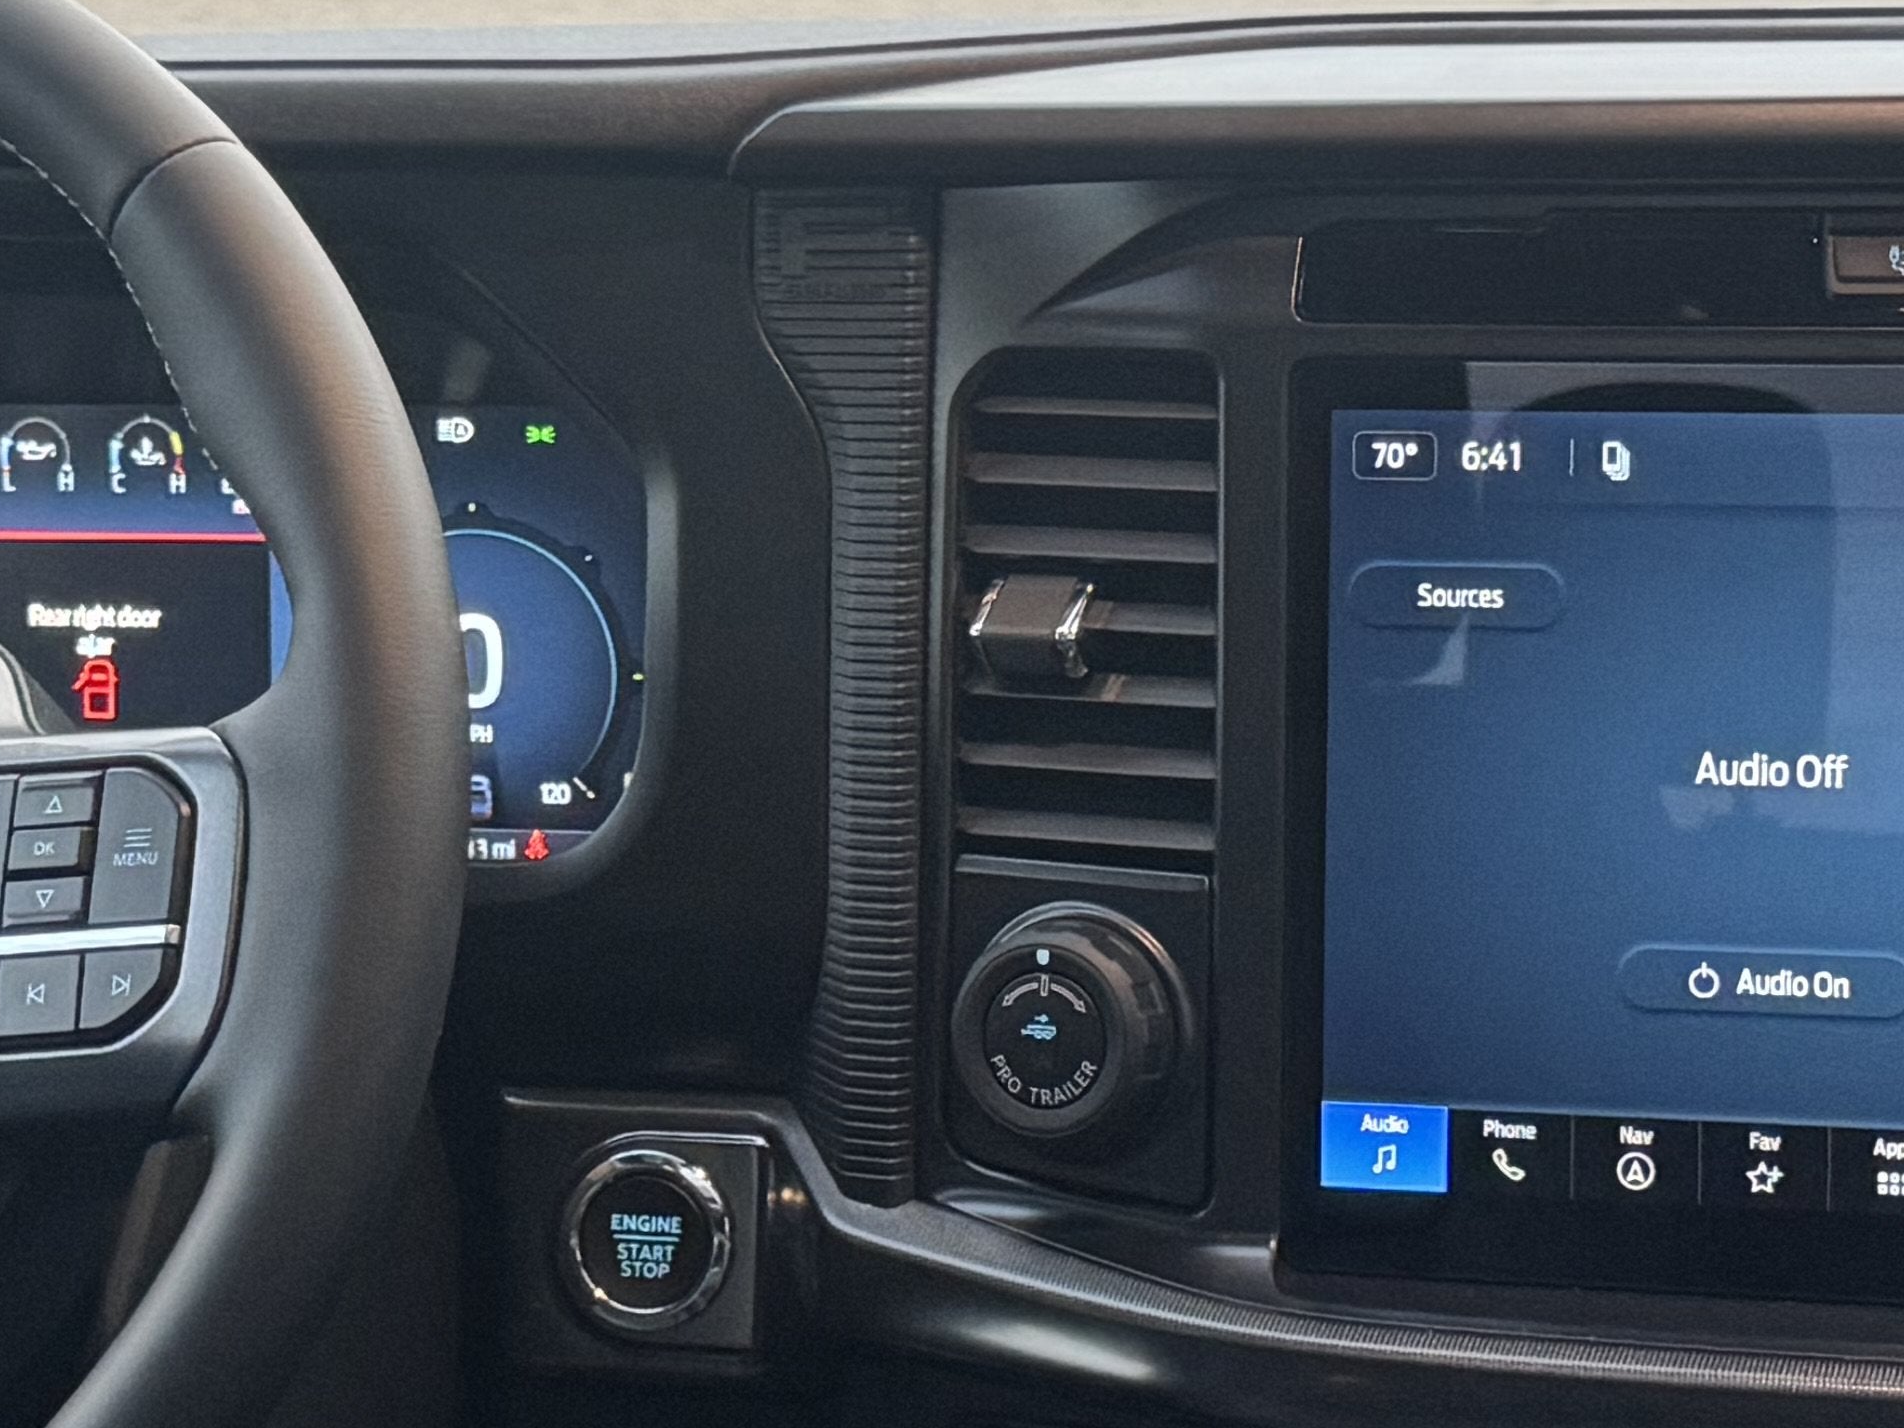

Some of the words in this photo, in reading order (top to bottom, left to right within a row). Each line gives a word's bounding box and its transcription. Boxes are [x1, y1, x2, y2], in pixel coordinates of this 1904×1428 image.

[1371, 441, 1419, 469] 70°
[1461, 441, 1522, 472] 6:41
[1, 471, 17, 492] L
[57, 471, 75, 492] H
[109, 471, 127, 494] C
[169, 472, 186, 494] H
[1416, 582, 1505, 609] Sources
[27, 602, 71, 627] Rear
[72, 603, 116, 631] right
[117, 604, 163, 629] door
[468, 724, 494, 745] PH
[1695, 750, 1790, 788] Audio
[1796, 753, 1850, 789] Off
[540, 781, 571, 806] 120
[33, 841, 56, 856] OK
[112, 852, 160, 867] MENU
[491, 837, 517, 860] mi
[1736, 968, 1809, 998] Audio
[1813, 970, 1851, 1000] On
[990, 1054, 1022, 1094] PRO
[1029, 1059, 1098, 1105] TRAILER
[1360, 1113, 1410, 1135] Audio
[1483, 1119, 1537, 1141] Phone
[1619, 1125, 1655, 1147] Nav
[1749, 1131, 1782, 1153] Fav
[609, 1213, 683, 1235] ENGINE
[616, 1243, 675, 1262] START
[620, 1261, 671, 1279] STOP
